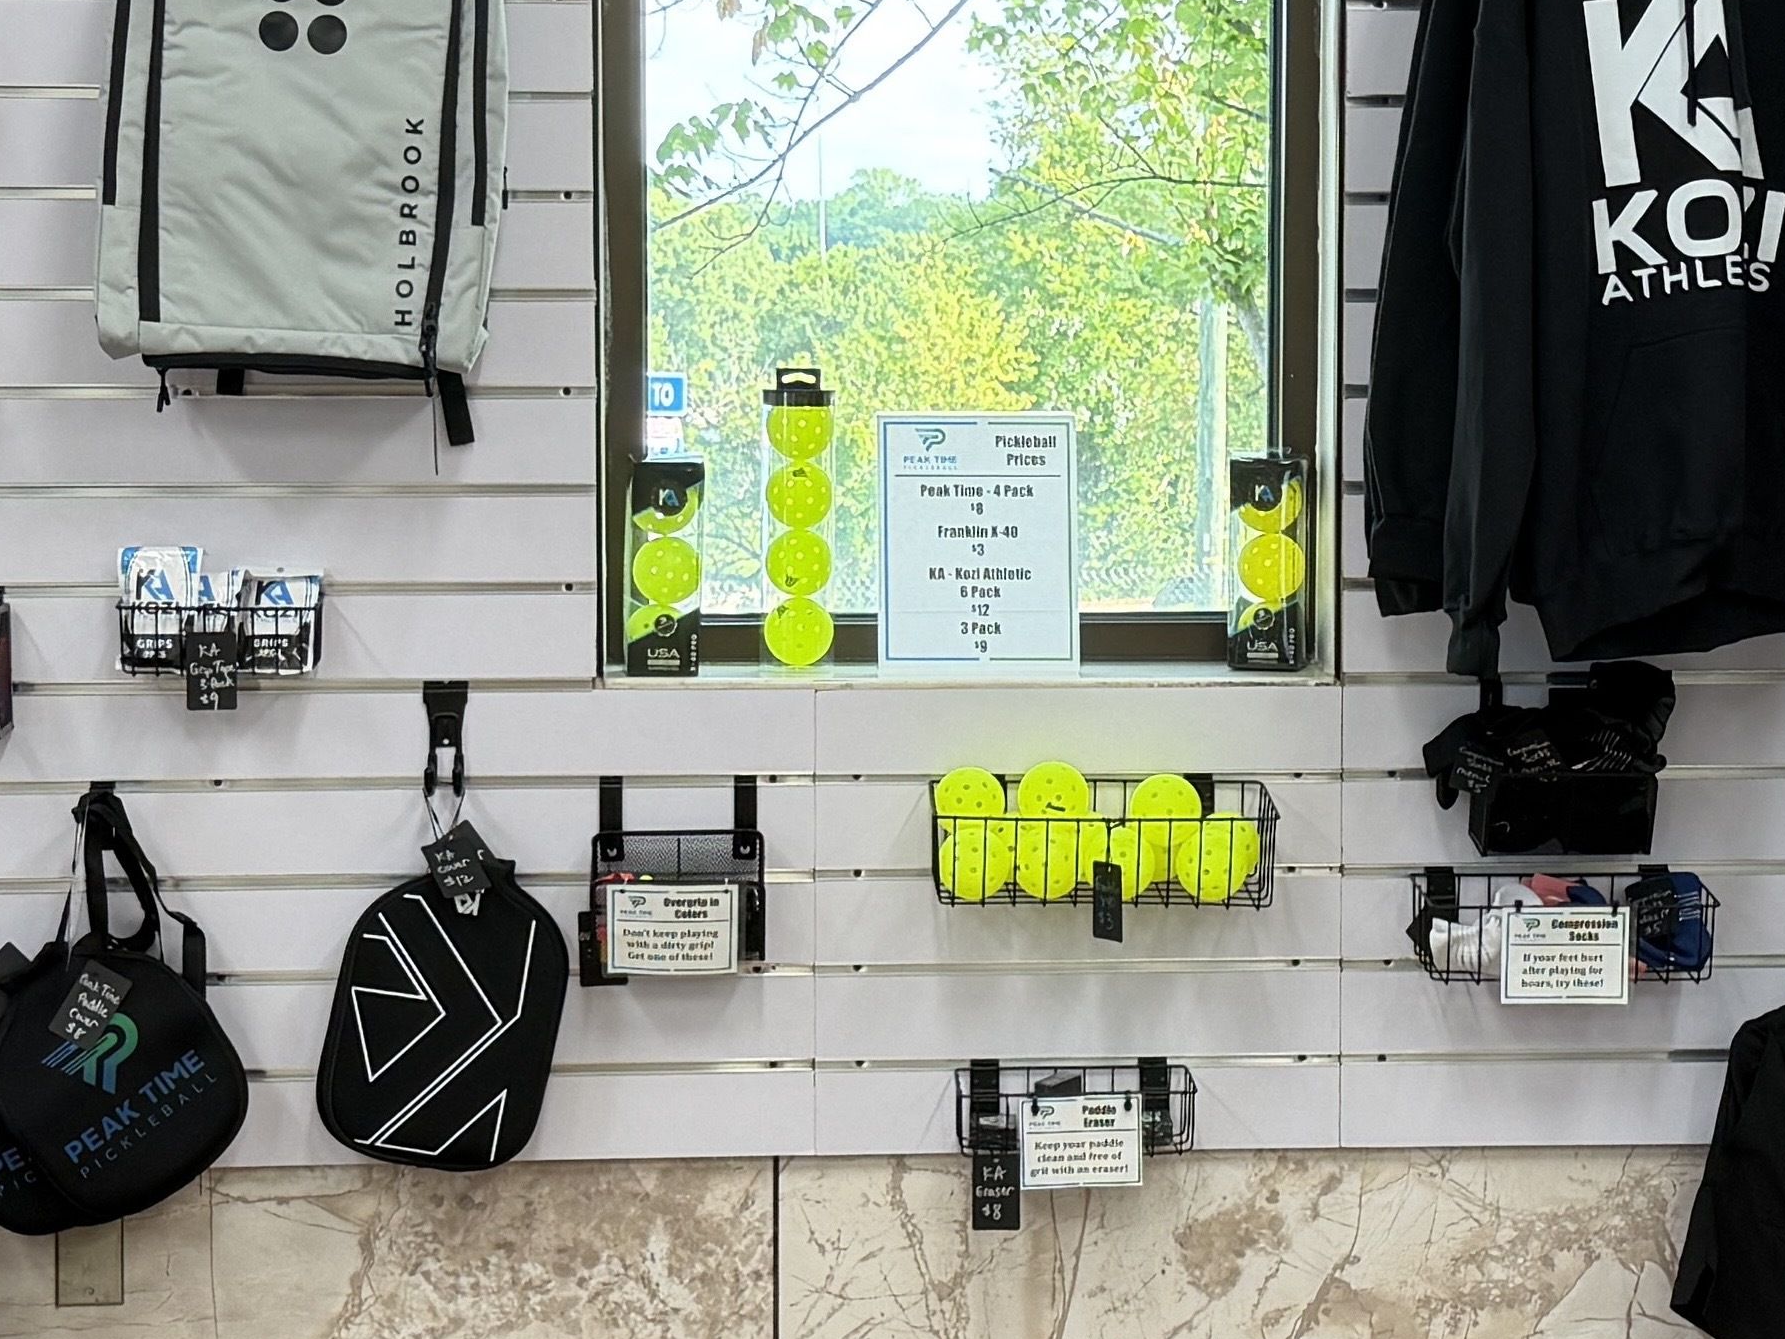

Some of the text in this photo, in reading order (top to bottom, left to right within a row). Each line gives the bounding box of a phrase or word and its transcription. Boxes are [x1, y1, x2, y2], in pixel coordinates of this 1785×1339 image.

[394, 119, 424, 326] HOLBROOK
[995, 435, 1057, 448] Pickleball
[1007, 454, 1046, 466] Prices
[920, 485, 950, 497] Peak
[953, 485, 983, 497] Time
[993, 485, 1001, 497] 4
[1004, 485, 1034, 497] Pack
[971, 502, 983, 515] $8
[938, 526, 1018, 538] Franklin X-40
[972, 544, 984, 556] $3
[930, 568, 945, 580] KA
[955, 568, 980, 580] Kozi
[983, 568, 1031, 580] Athletic
[135, 568, 174, 600] KA
[961, 586, 1001, 598] 6 Pack
[972, 604, 989, 616] $12
[961, 623, 1001, 634] 3 Pack
[975, 641, 987, 653] $9
[1247, 641, 1278, 651] USA
[647, 648, 680, 659] USA
[444, 875, 474, 886] $12
[664, 897, 708, 908] Overgrip
[674, 909, 708, 919] Colors
[623, 929, 719, 939] Don't keep playing
[627, 940, 650, 949] with
[660, 940, 686, 950] dirty
[628, 952, 645, 960] Get
[669, 953, 679, 961] of
[682, 953, 713, 961] these!
[63, 1049, 205, 1164] PEAK TIME
[79, 1073, 217, 1179] PICKLEBALL
[983, 1166, 1006, 1181] KA
[976, 1186, 1015, 1198] Eraser
[982, 1204, 1001, 1220] $8
